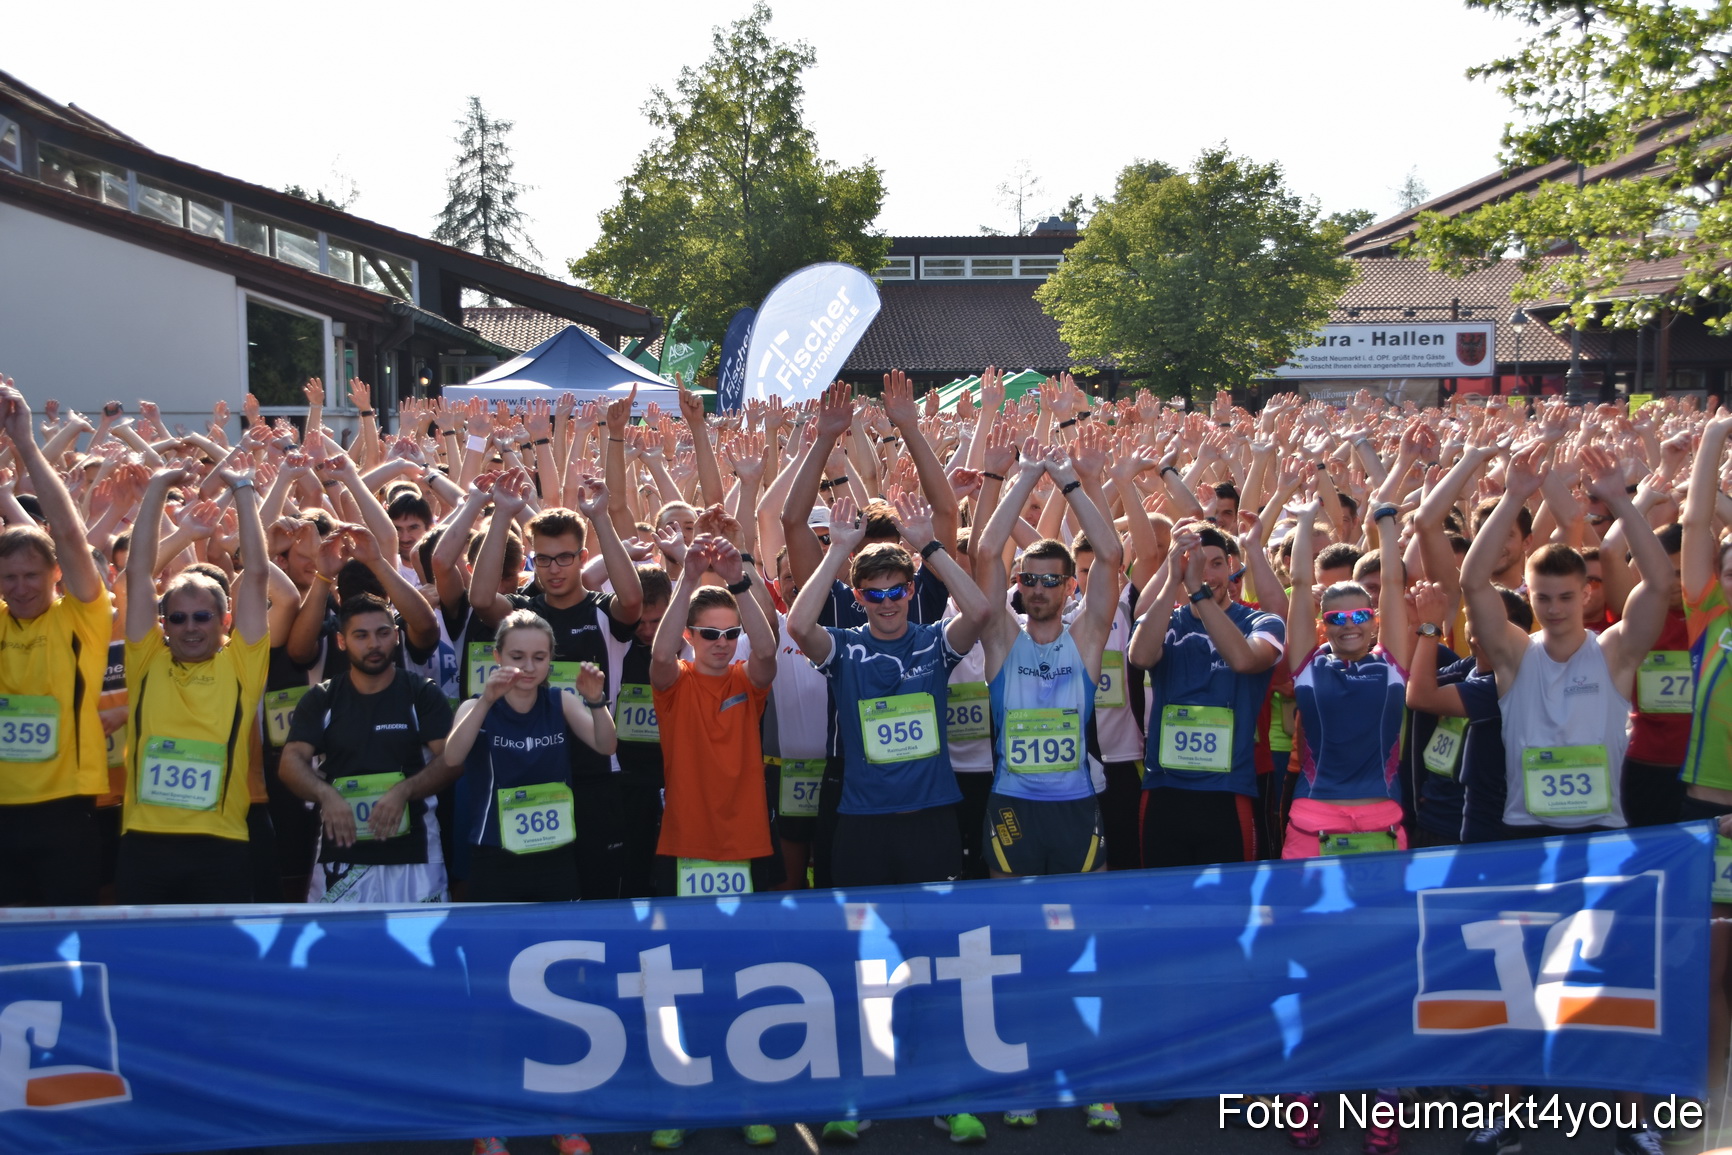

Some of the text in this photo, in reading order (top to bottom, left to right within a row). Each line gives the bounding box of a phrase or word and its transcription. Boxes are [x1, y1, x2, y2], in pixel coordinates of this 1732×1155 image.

[775, 285, 850, 391] Fischer
[802, 304, 860, 390] AUTOMOBILE
[1371, 331, 1445, 346] Hallen
[726, 324, 751, 400] Fischer
[1373, 362, 1416, 370] angenehmen
[1392, 354, 1411, 362] grüßt
[1411, 353, 1425, 361] ihre
[1425, 353, 1446, 361] Gäste
[2, 722, 51, 744] 359
[493, 733, 565, 749] EURO POLES
[877, 720, 923, 745] 956
[1174, 731, 1217, 753] 958
[1010, 737, 1076, 764] 5193
[1432, 734, 1454, 758] 381
[150, 763, 212, 791] 1361
[1541, 773, 1592, 797] 353
[515, 809, 560, 835] 368
[686, 872, 746, 894] 1030
[509, 925, 1030, 1094] Start
